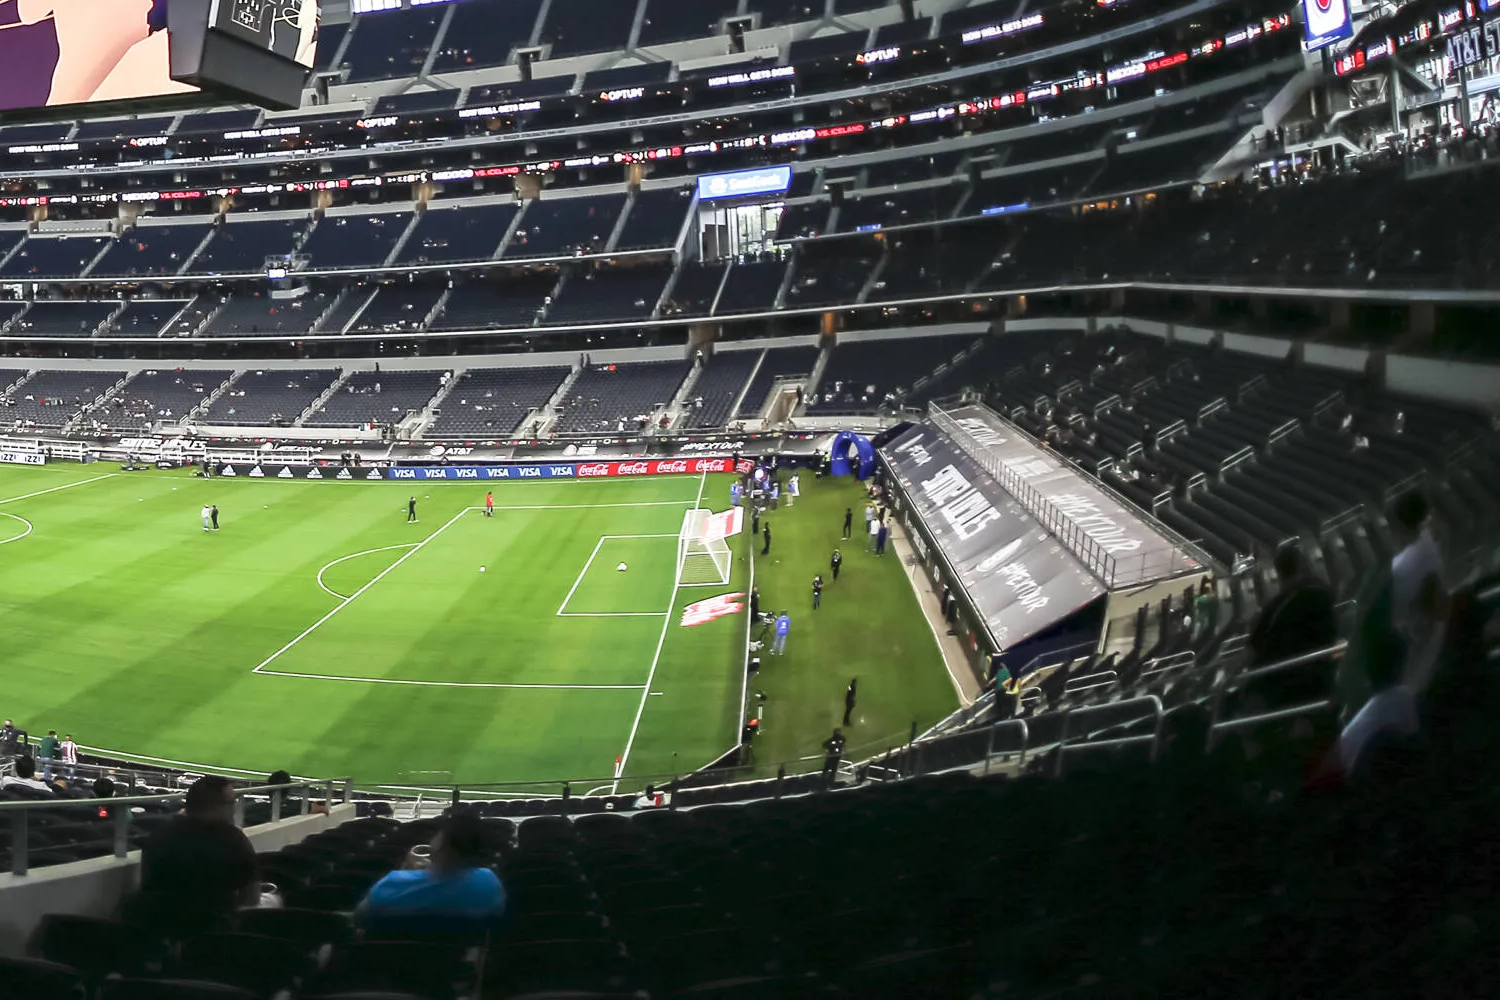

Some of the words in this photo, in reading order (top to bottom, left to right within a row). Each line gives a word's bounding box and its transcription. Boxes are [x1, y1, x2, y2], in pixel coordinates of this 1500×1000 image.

[1447, 27, 1481, 70] AT&T
[864, 48, 900, 63] OPTUM
[608, 88, 644, 100] OPTUM
[364, 117, 398, 128] OPTUM
[445, 447, 474, 455] AT&T
[680, 441, 744, 451] #MEXTOUR
[393, 469, 415, 478] VISA
[424, 469, 446, 478] VISA
[456, 468, 477, 478] VISA
[487, 468, 509, 477] VISA
[518, 467, 541, 477] VISA
[550, 467, 573, 476] VISA
